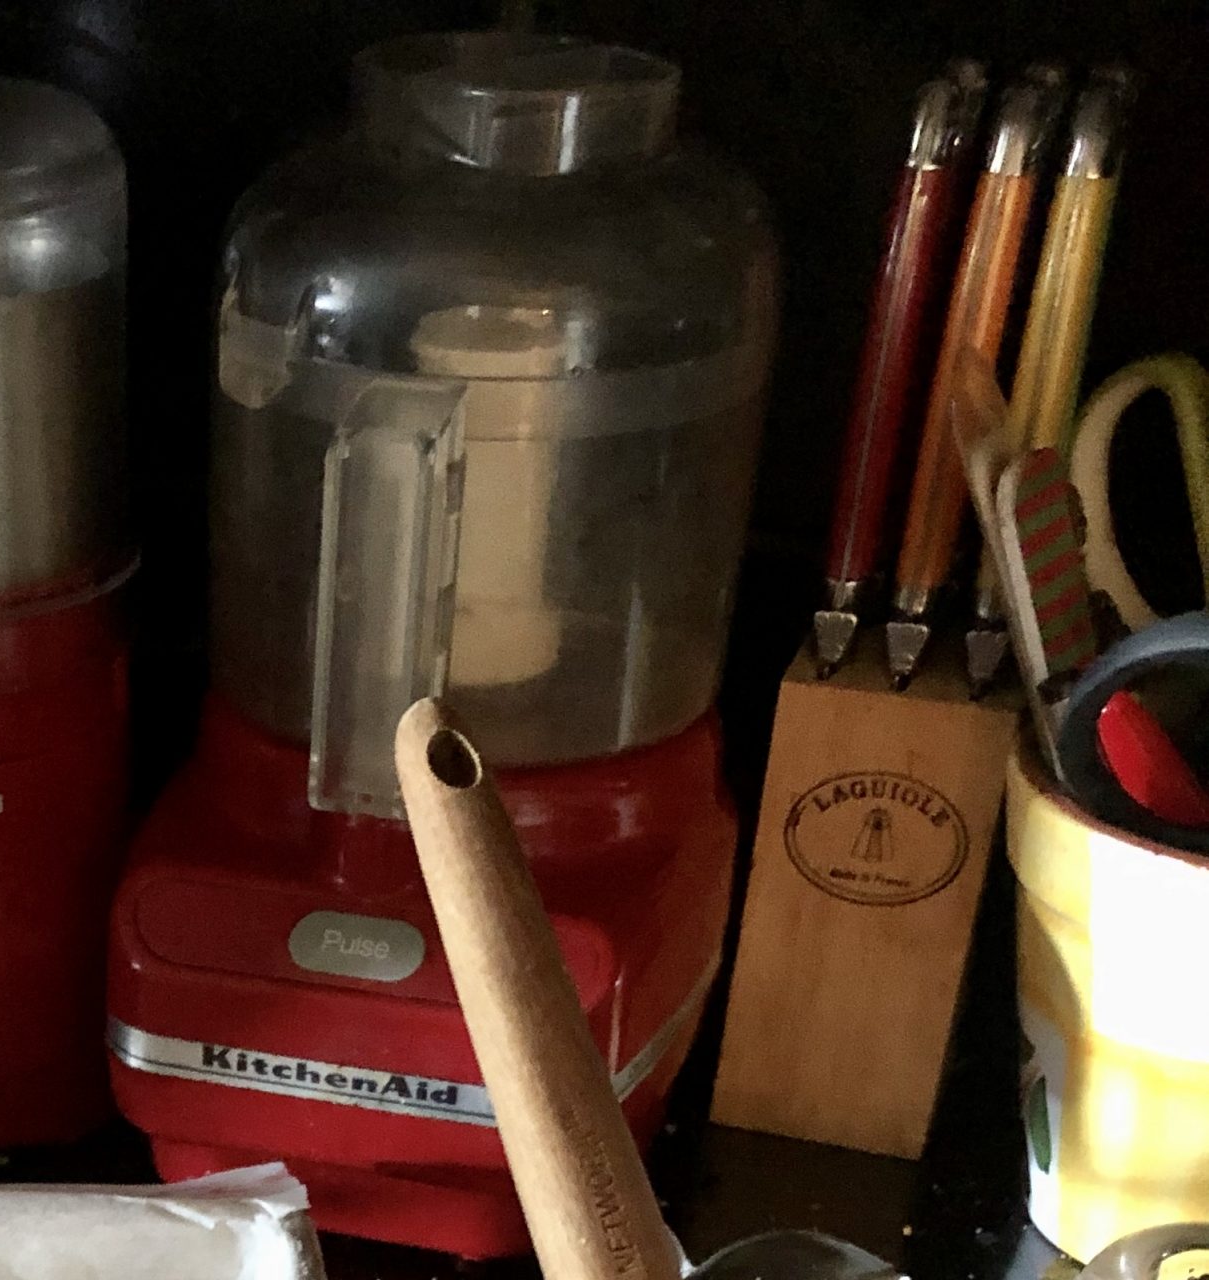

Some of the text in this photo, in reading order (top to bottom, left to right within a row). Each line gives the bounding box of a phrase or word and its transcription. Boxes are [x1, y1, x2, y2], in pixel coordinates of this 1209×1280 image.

[811, 779, 951, 828] LAGUIOLE
[320, 927, 392, 961] Pulse
[201, 1046, 460, 1107] KitchenAid
